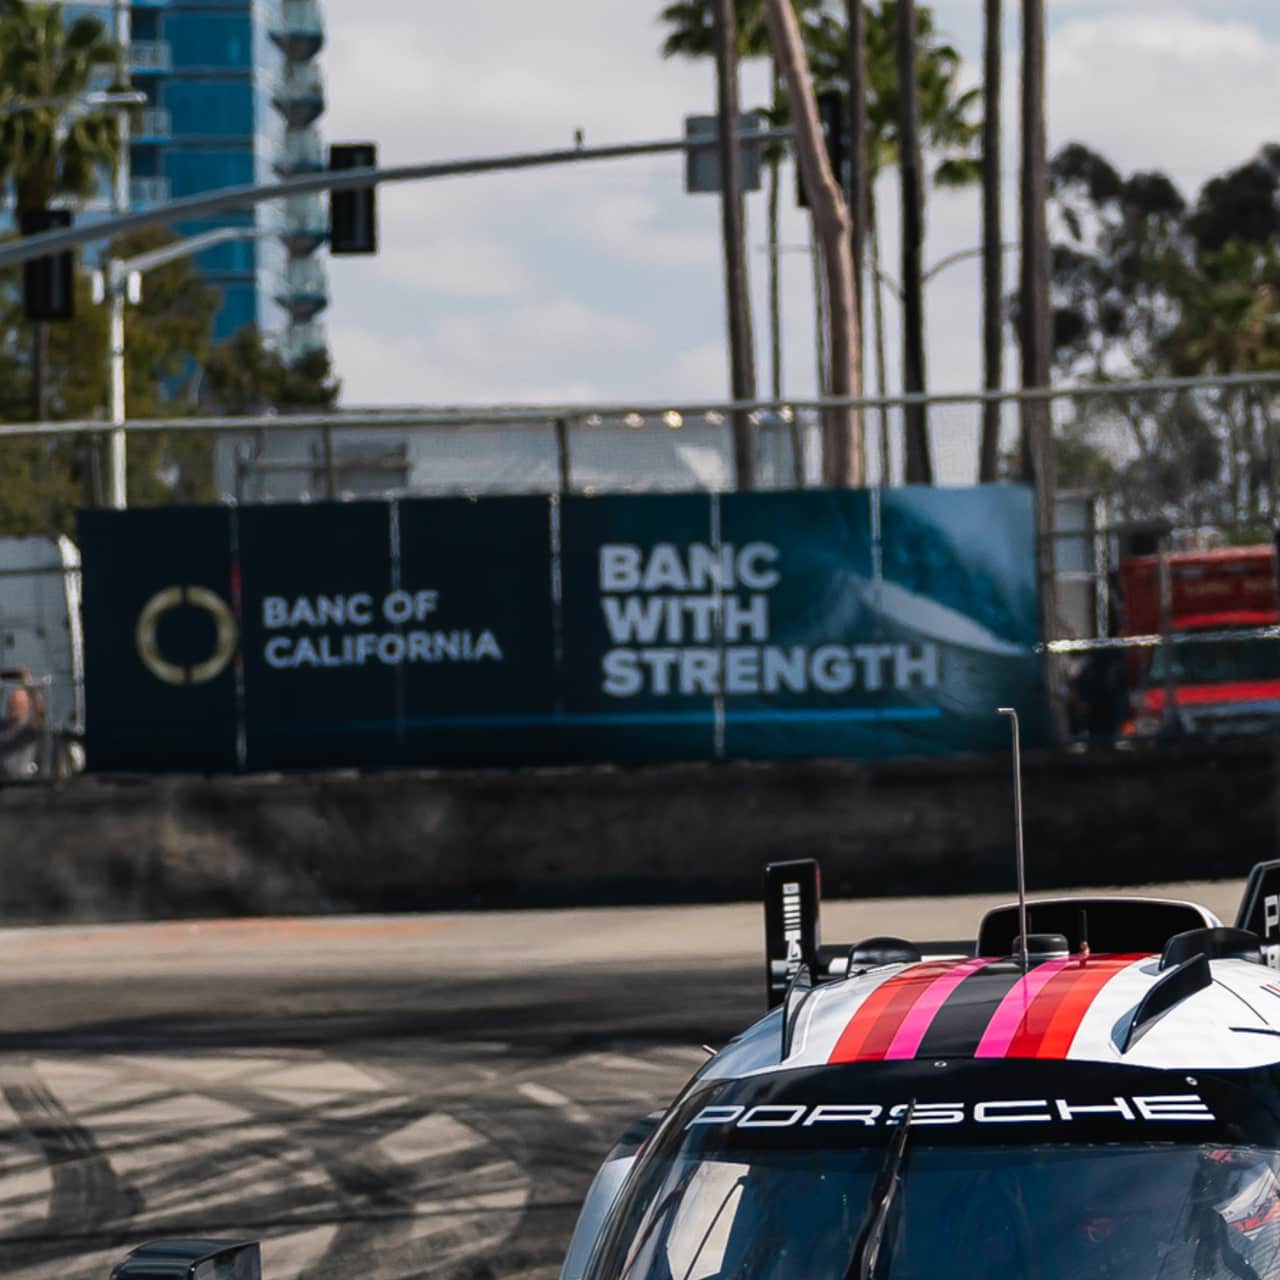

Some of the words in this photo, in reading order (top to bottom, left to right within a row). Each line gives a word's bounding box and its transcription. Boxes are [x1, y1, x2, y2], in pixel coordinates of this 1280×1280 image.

[598, 541, 781, 592] BANC
[262, 593, 374, 628] BANC
[382, 589, 439, 624] OF
[600, 593, 769, 644] WITH
[264, 628, 503, 669] CALIFORNIA
[601, 641, 939, 697] STRENGTH
[685, 1094, 1216, 1130] PORSCHE
